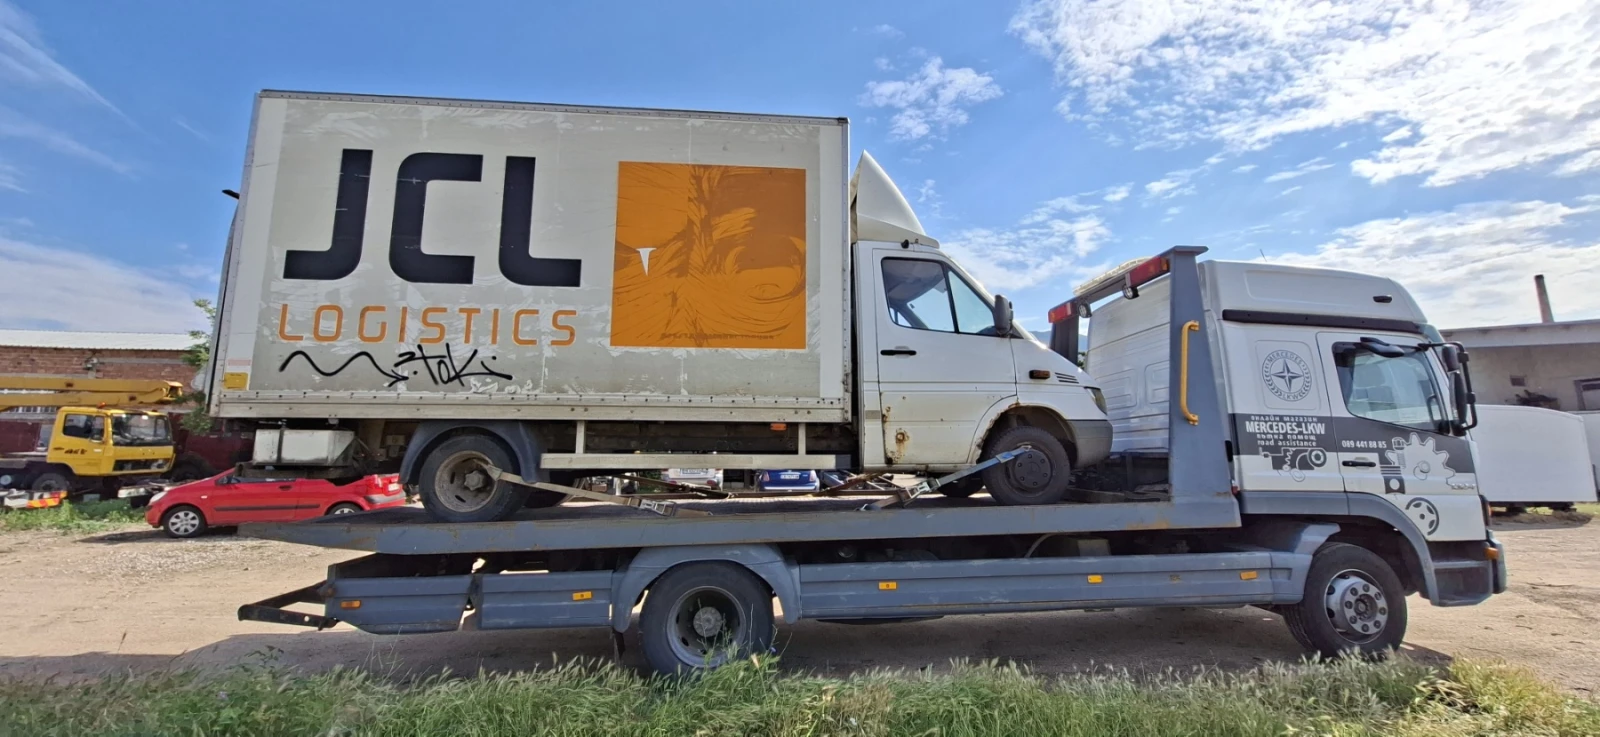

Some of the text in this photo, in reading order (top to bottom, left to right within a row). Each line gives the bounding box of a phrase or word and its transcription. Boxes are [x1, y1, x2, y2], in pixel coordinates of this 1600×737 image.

[283, 148, 582, 288] JCL
[278, 303, 577, 346] LOGISTICS
[1245, 421, 1325, 434] MERCEDES-LKW
[1356, 440, 1368, 448] 441
